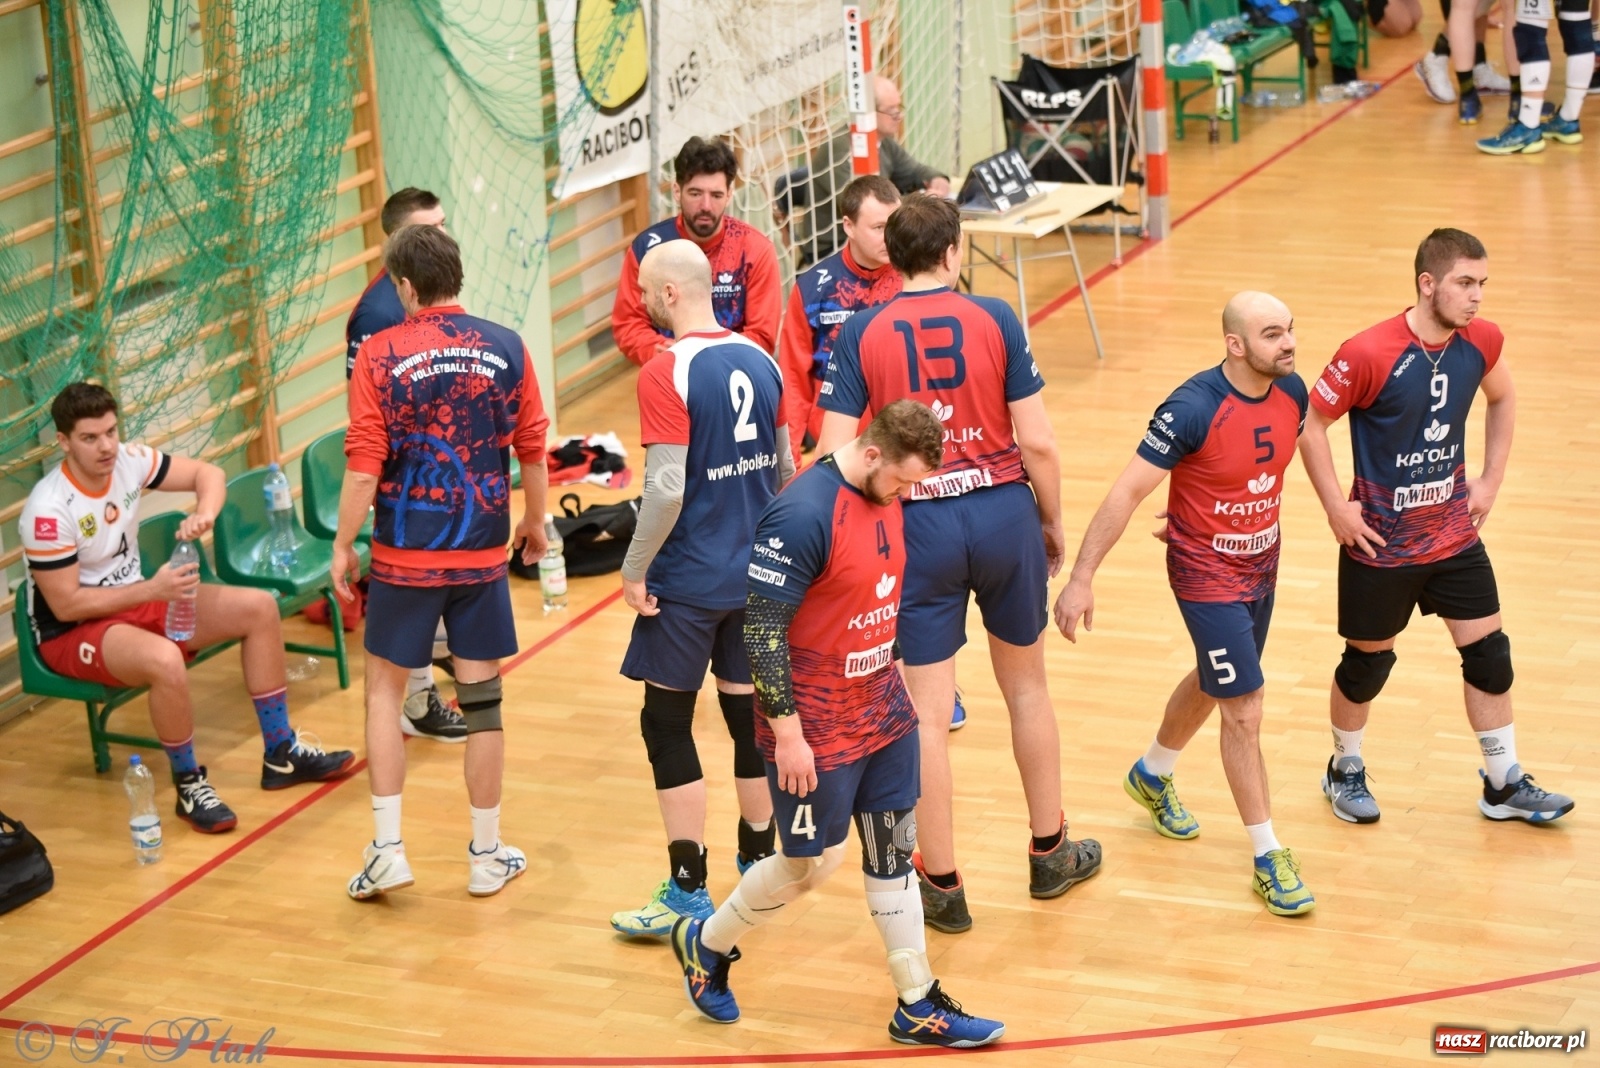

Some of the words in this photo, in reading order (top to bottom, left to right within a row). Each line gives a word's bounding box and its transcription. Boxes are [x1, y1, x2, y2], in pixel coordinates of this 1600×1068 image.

[1021, 89, 1082, 109] RLPS
[391, 349, 442, 378] NOWINY.PL
[443, 347, 482, 360] KATOLIK
[482, 351, 508, 371] GROUP
[893, 316, 966, 393] 13
[410, 362, 468, 382] VOLLEYBALL
[470, 363, 496, 380] TEAM
[729, 369, 758, 443] 2
[1430, 373, 1449, 413] 9
[1253, 425, 1275, 465] 5
[1214, 492, 1280, 516] KATOLI
[1231, 512, 1272, 527] GROU
[111, 532, 129, 560] 4
[876, 520, 891, 561] 4
[847, 597, 901, 630] KATOL
[847, 646, 891, 673] nowin
[1207, 647, 1237, 685] 5
[790, 804, 817, 840] 4
